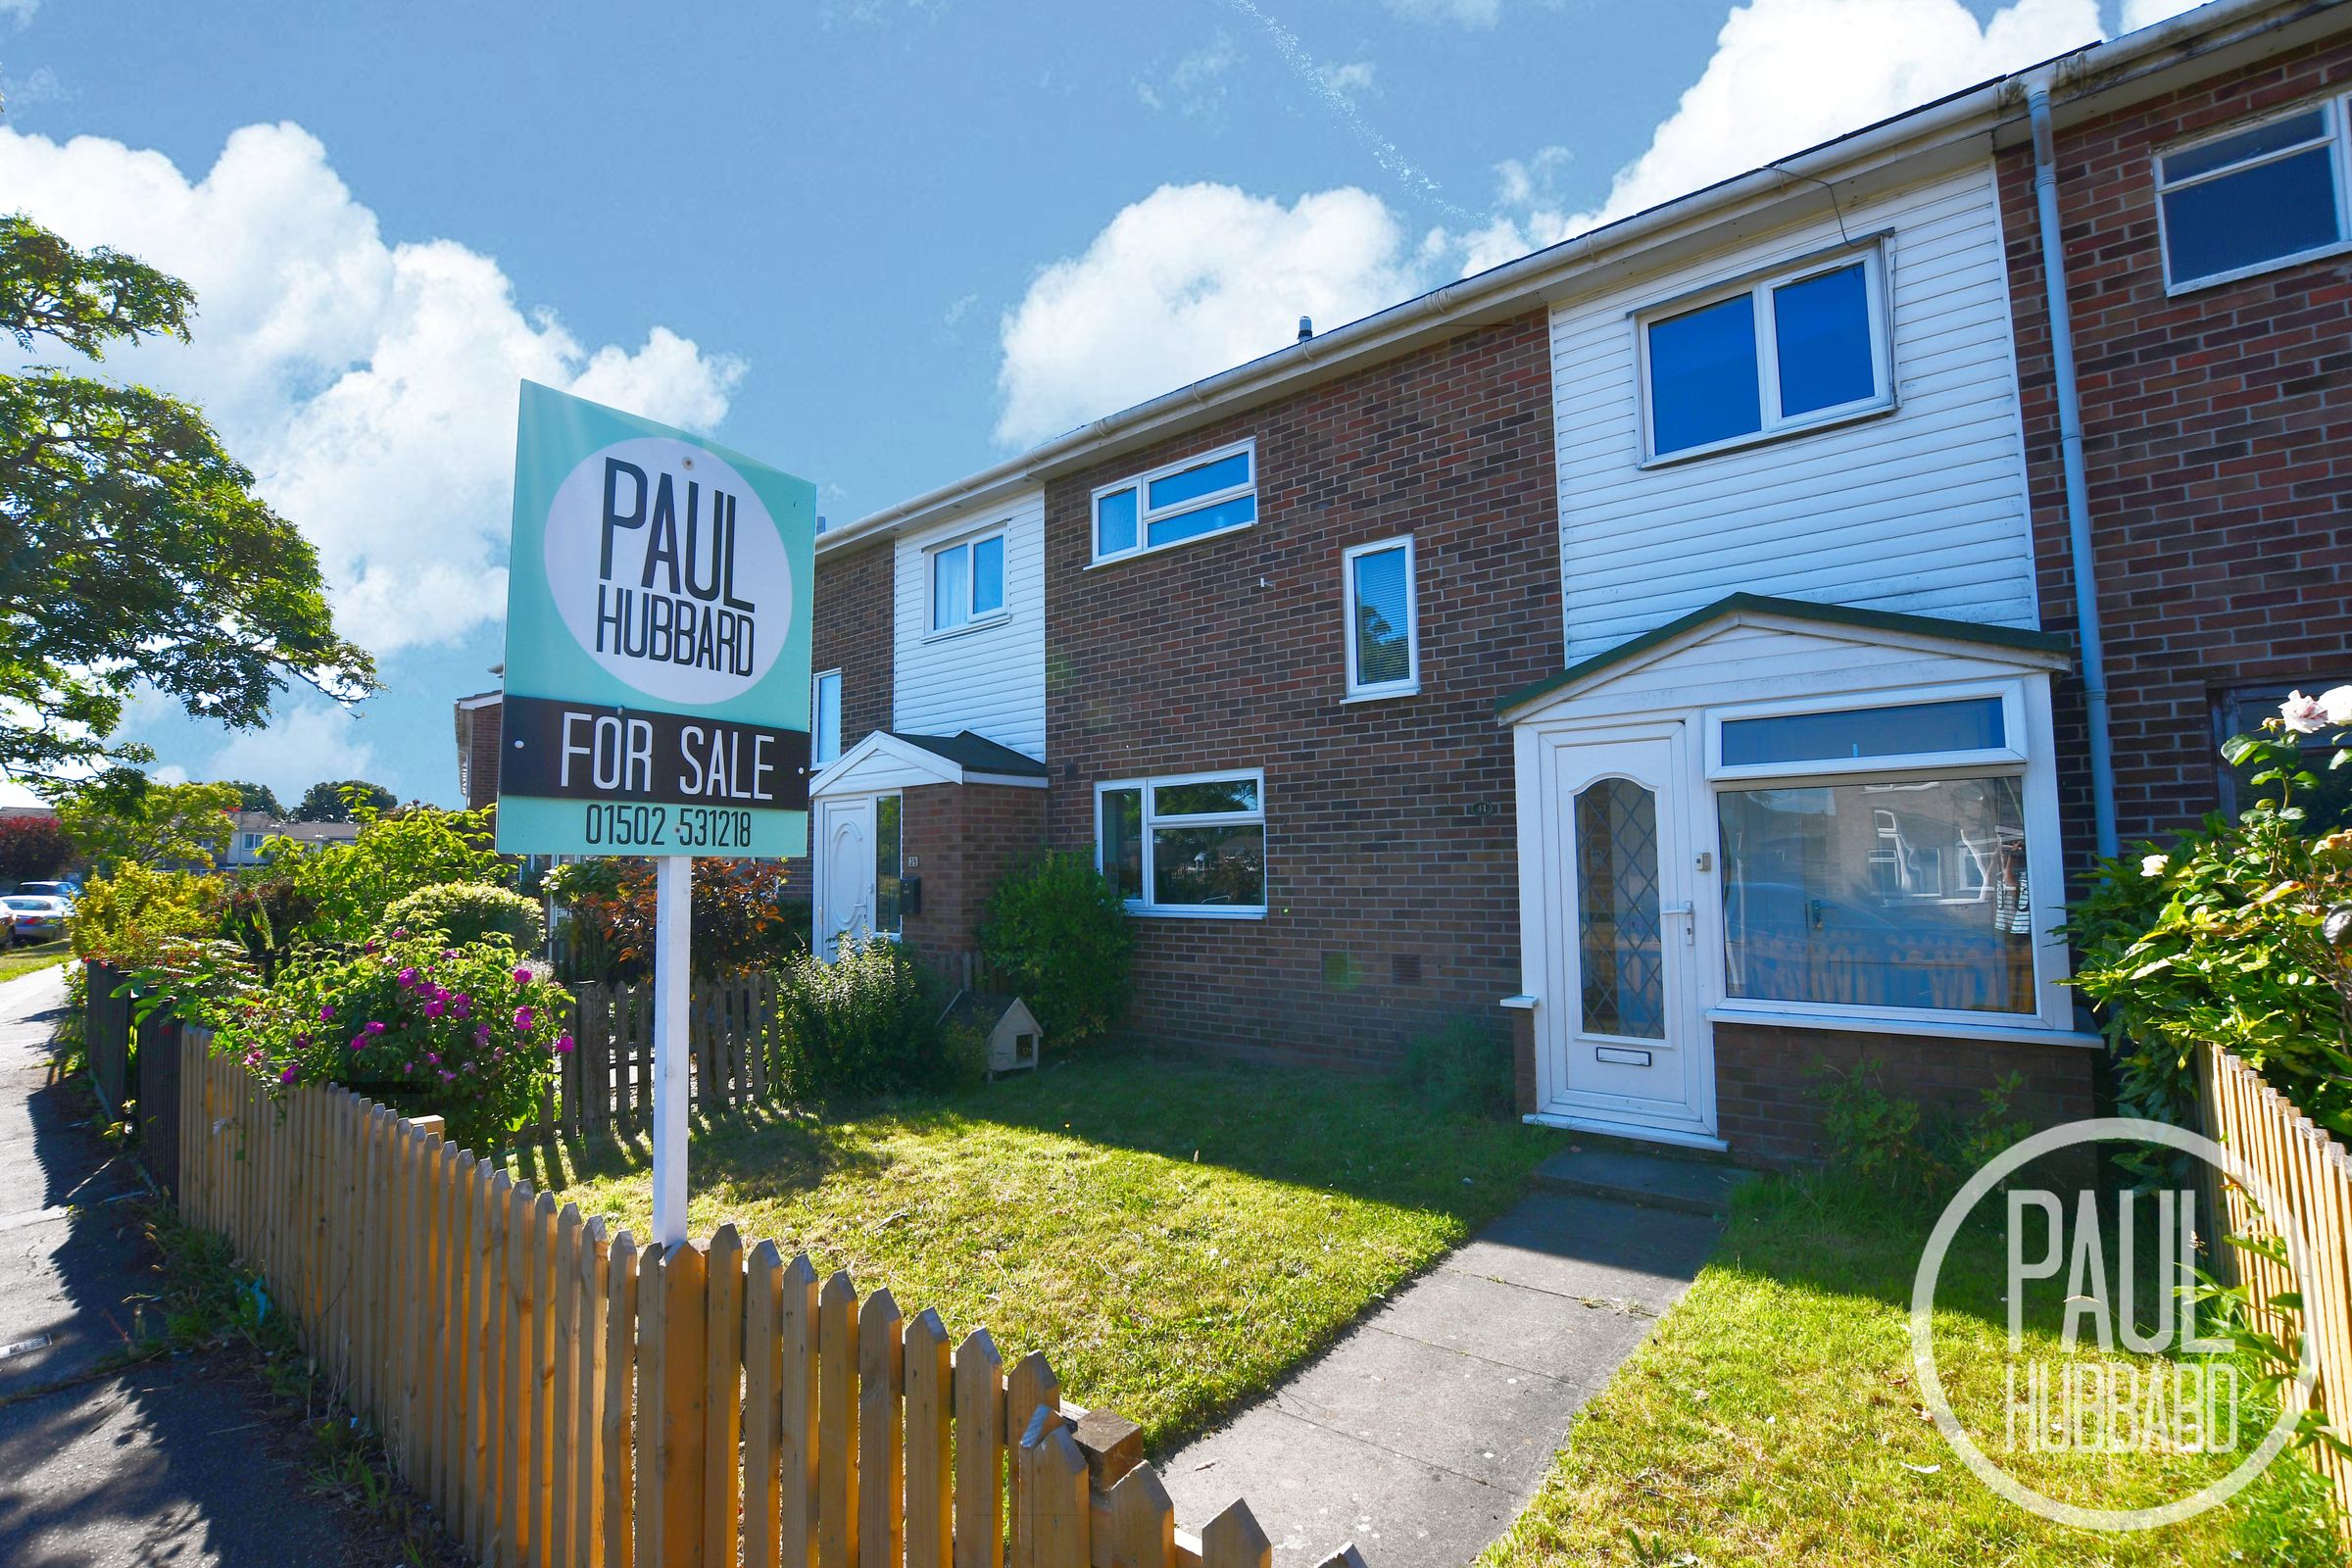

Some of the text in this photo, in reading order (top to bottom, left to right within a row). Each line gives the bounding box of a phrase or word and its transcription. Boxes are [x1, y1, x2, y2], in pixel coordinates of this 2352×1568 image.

[599, 456, 756, 613] PAUL
[595, 584, 756, 677] HUBBARD
[561, 711, 775, 801] FOR SALE
[585, 804, 752, 848] 01502 531218
